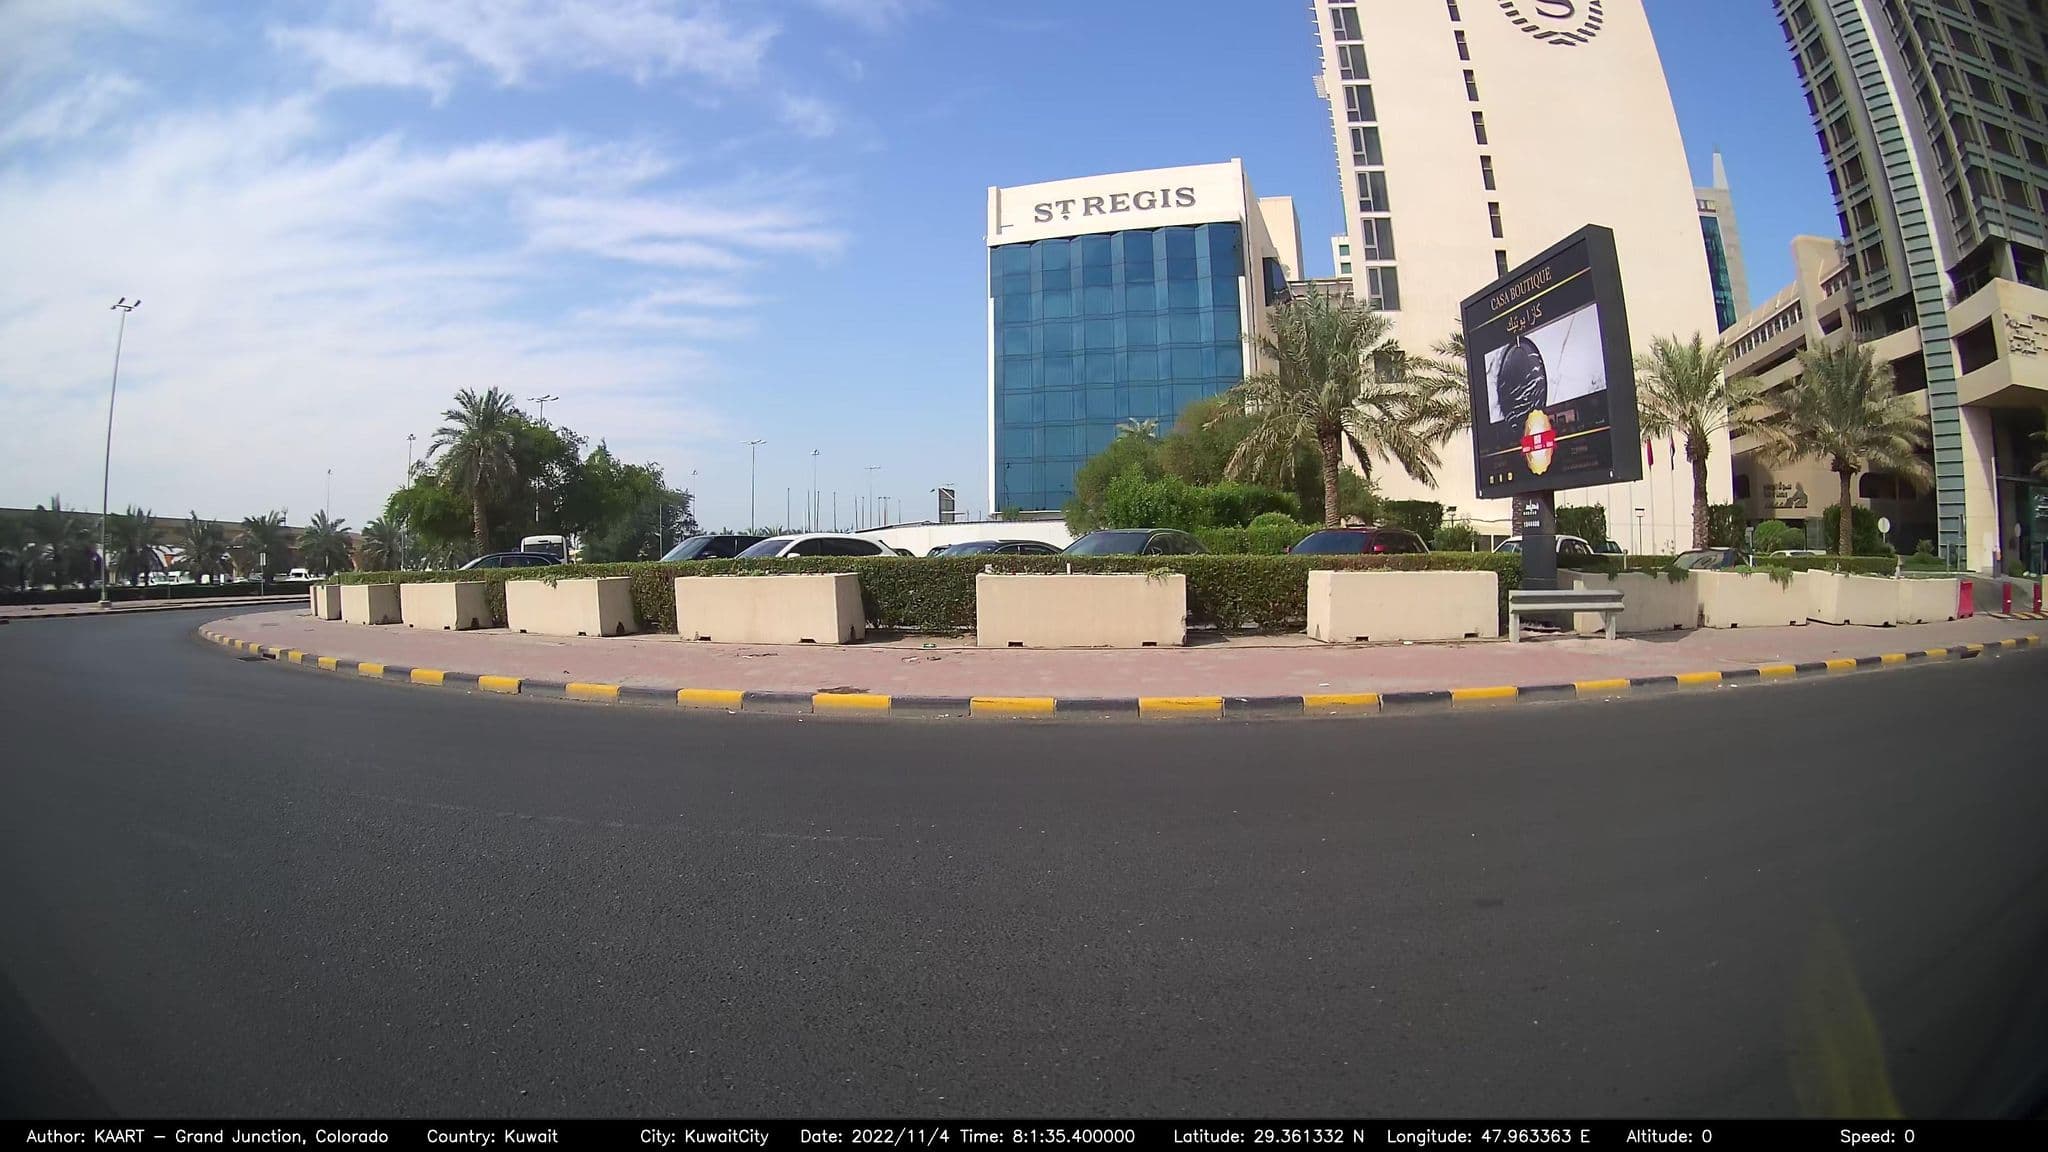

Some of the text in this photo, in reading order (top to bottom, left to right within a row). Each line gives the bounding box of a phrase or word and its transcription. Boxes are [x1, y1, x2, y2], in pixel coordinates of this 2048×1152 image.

[1083, 187, 1196, 217] REGIS
[1490, 266, 1552, 311] CASA BOUTIQUE
